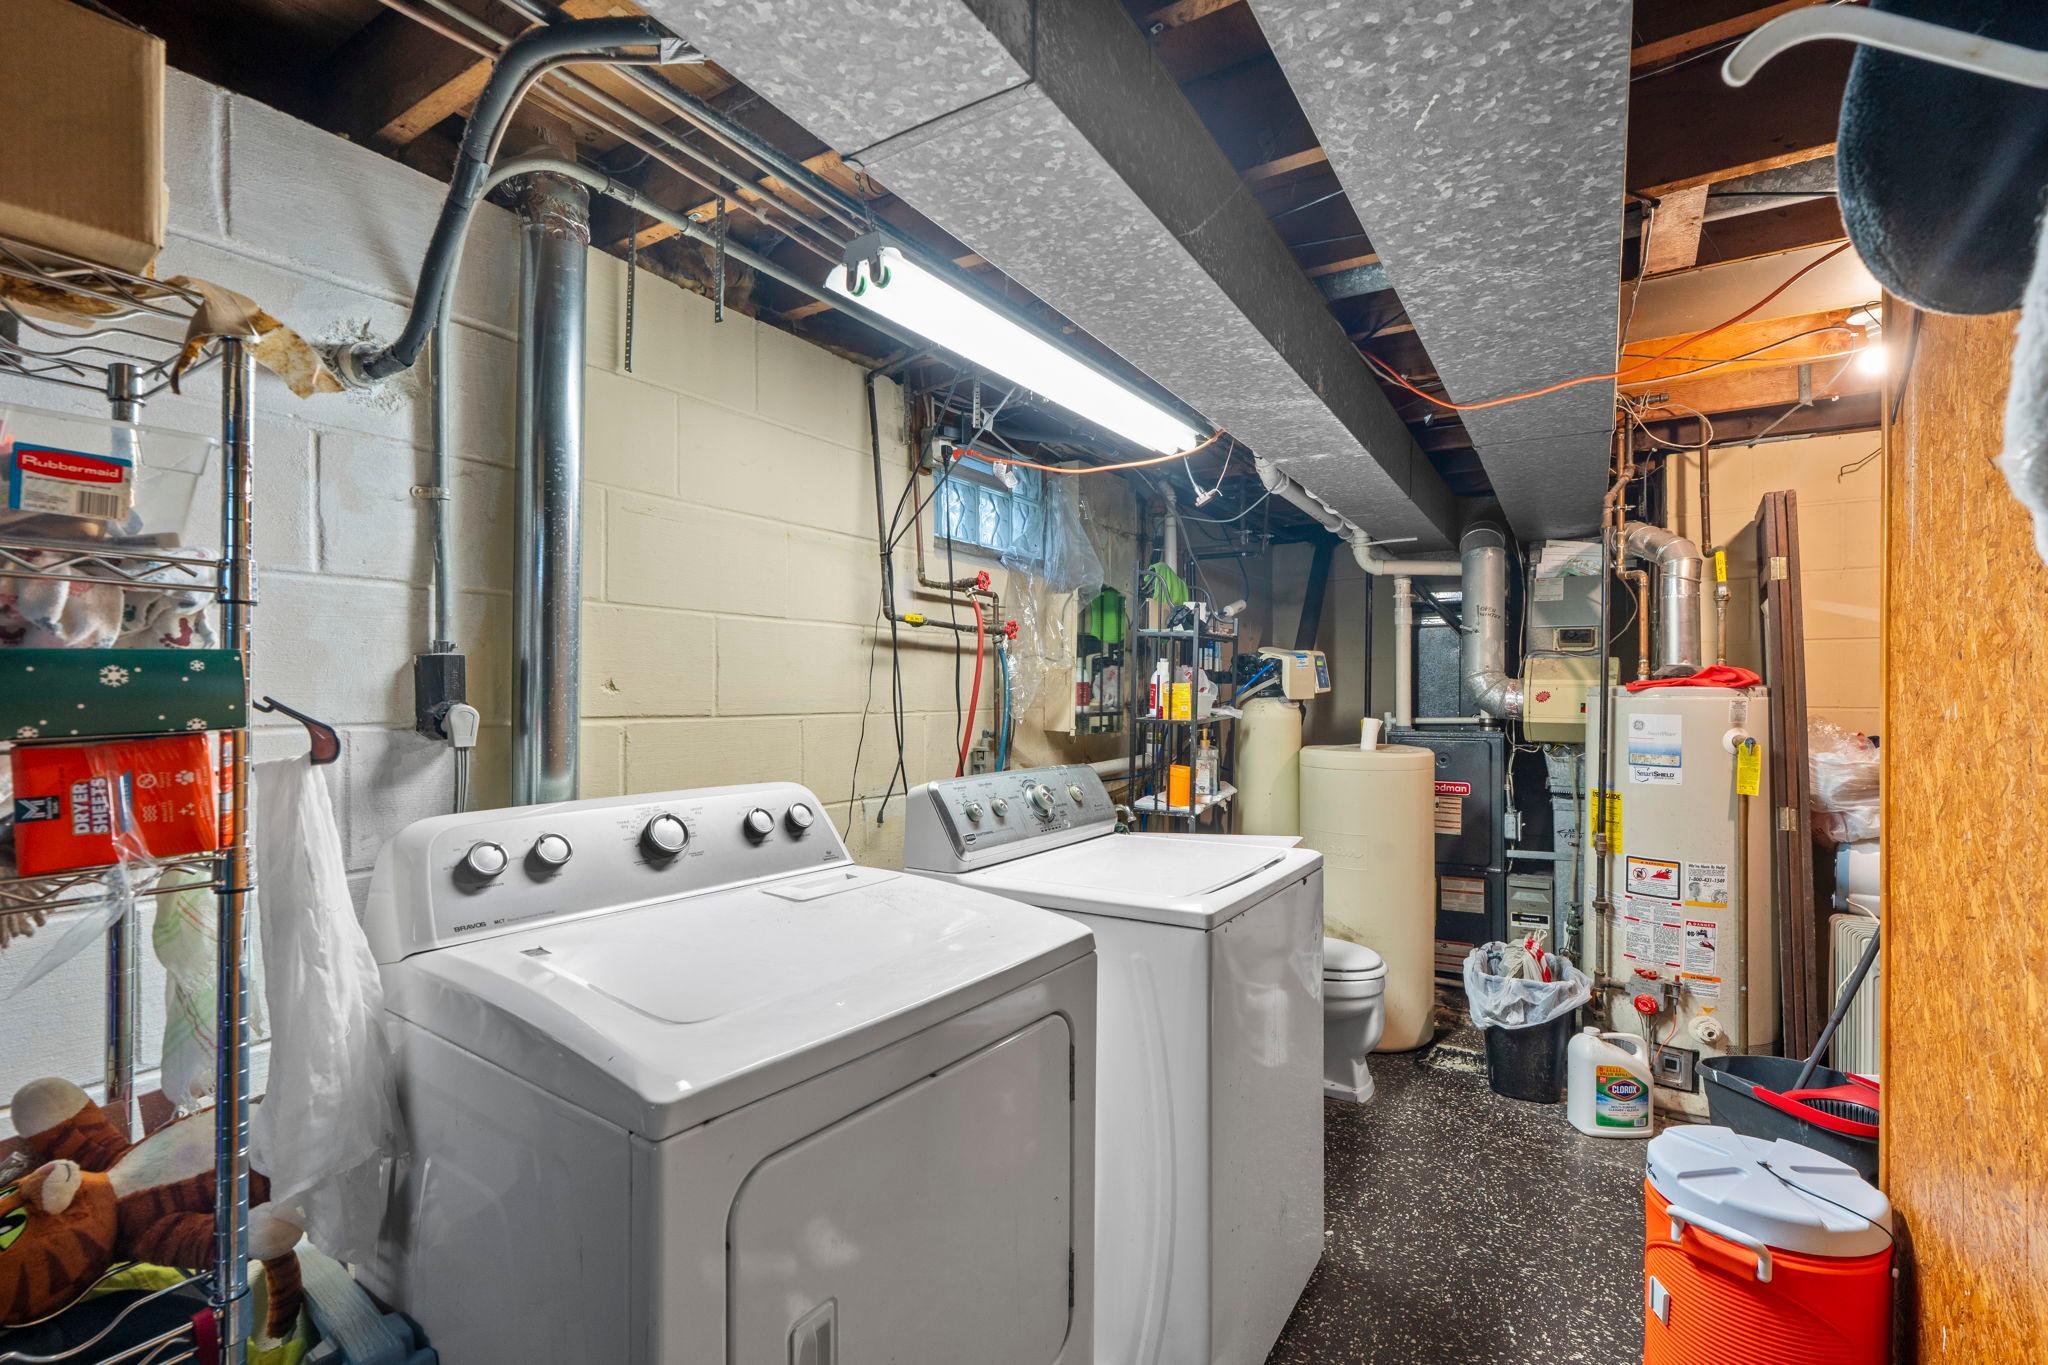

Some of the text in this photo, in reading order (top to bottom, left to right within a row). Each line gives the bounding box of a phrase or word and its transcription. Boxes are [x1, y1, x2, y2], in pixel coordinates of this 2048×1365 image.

[21, 454, 120, 478] Rubbermaid
[1435, 783, 1468, 794] odman
[73, 784, 89, 835] DRYER
[91, 777, 111, 834] SHEETS
[1612, 1085, 1637, 1094] CLOROX
